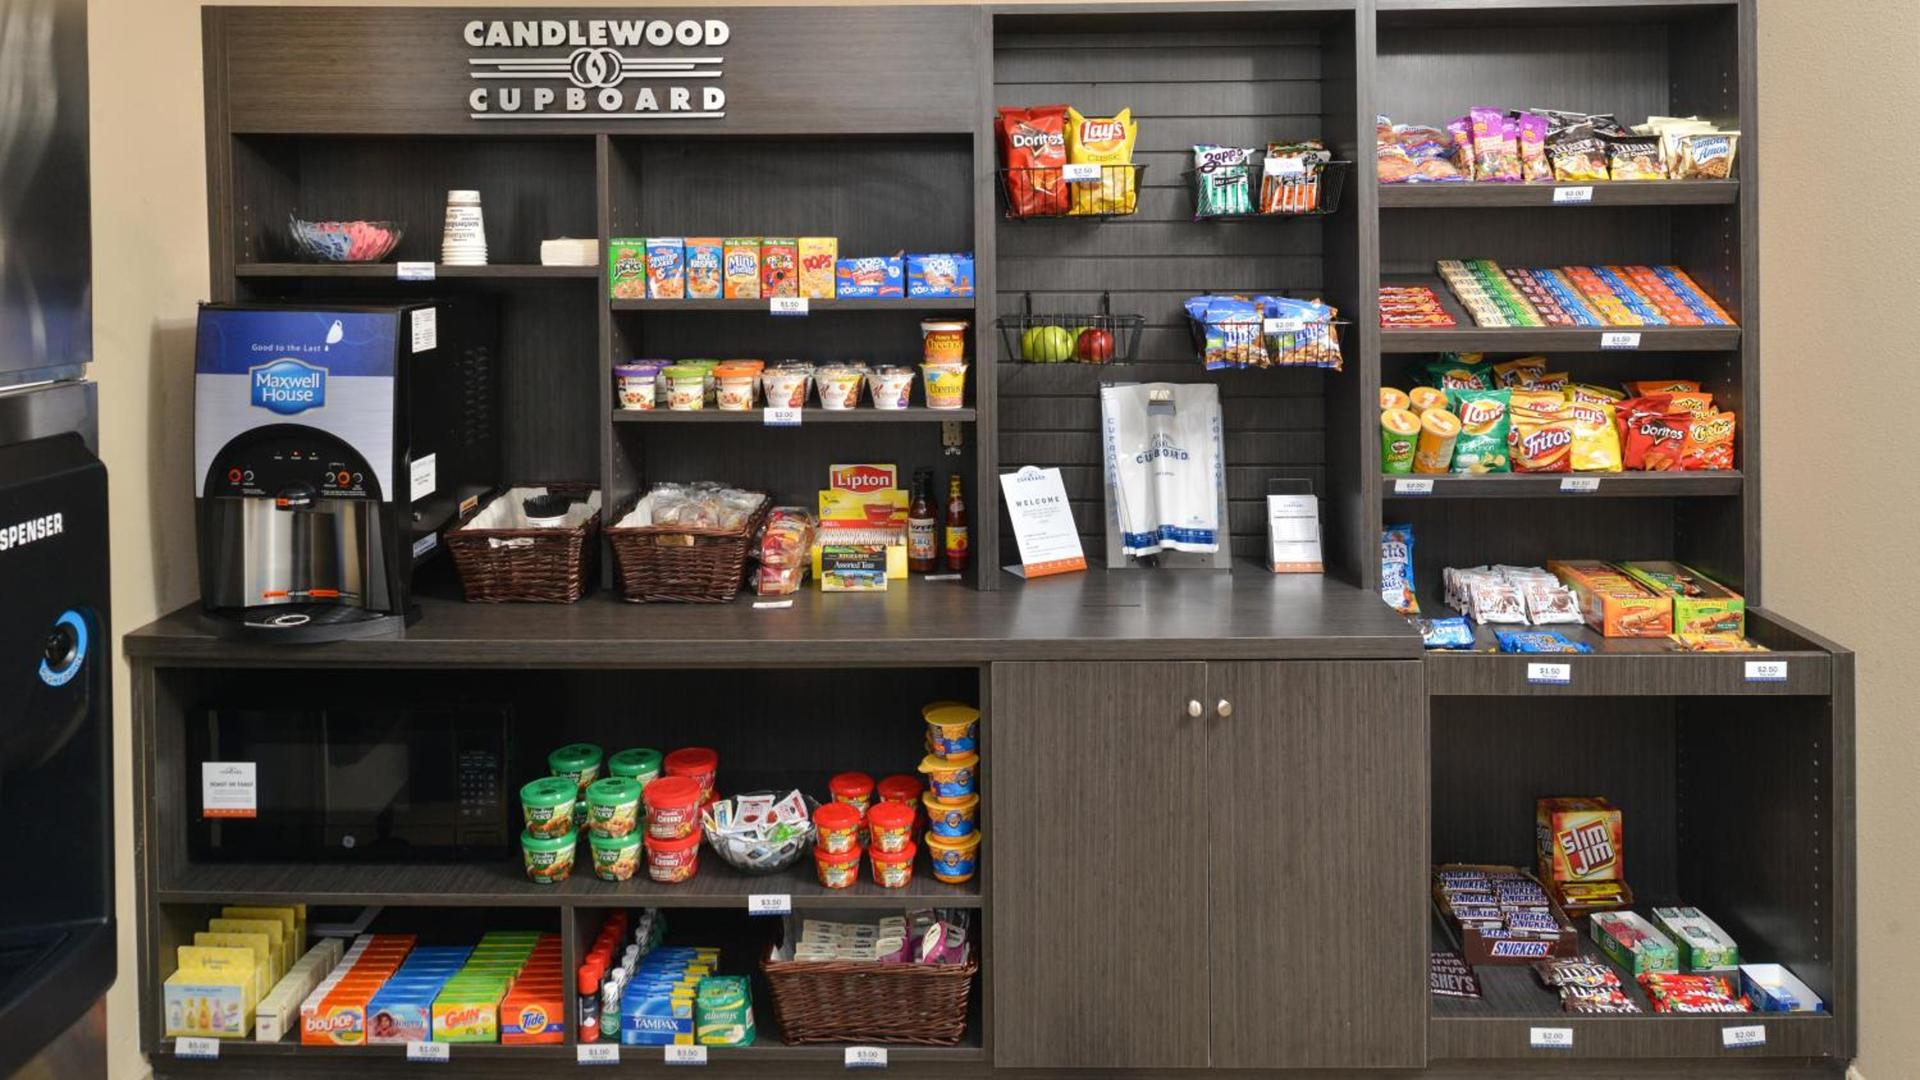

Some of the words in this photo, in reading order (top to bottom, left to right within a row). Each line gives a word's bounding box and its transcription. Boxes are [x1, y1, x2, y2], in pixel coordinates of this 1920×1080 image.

[464, 20, 730, 47] CANDLEWOOD
[469, 87, 726, 111] CUPBOARD
[1012, 133, 1066, 148] Doritos
[1697, 145, 1727, 160] Amos
[728, 255, 755, 268] Mini
[802, 254, 833, 271] POPS
[614, 262, 642, 279] JACKS
[252, 343, 274, 352] Good
[275, 344, 285, 352] to
[287, 343, 300, 352] the
[303, 344, 321, 352] Last
[256, 373, 320, 389] Maxwell
[262, 388, 314, 402] House
[1640, 424, 1684, 441] Doritos
[1523, 428, 1572, 458] Fritos
[837, 470, 889, 489] Lipton
[1015, 495, 1060, 507] WELCOME
[0, 512, 63, 551] SPENSER
[1539, 667, 1561, 675] $1.50
[1562, 825, 1609, 855] slim
[1575, 841, 1614, 875] jim
[1446, 879, 1491, 889] SNICKERS
[1452, 893, 1497, 903] SNICKERS
[1456, 908, 1499, 918] SNICKERS
[1508, 911, 1553, 921] SNICKERS
[1513, 919, 1558, 930] SNICKERS
[1494, 942, 1548, 956] SNICKERS
[522, 1011, 545, 1029] Tide
[704, 1011, 738, 1021] always
[633, 1017, 679, 1030] TAMPAX
[1542, 1032, 1564, 1040] $2.00
[1734, 1031, 1756, 1039] $2.00
